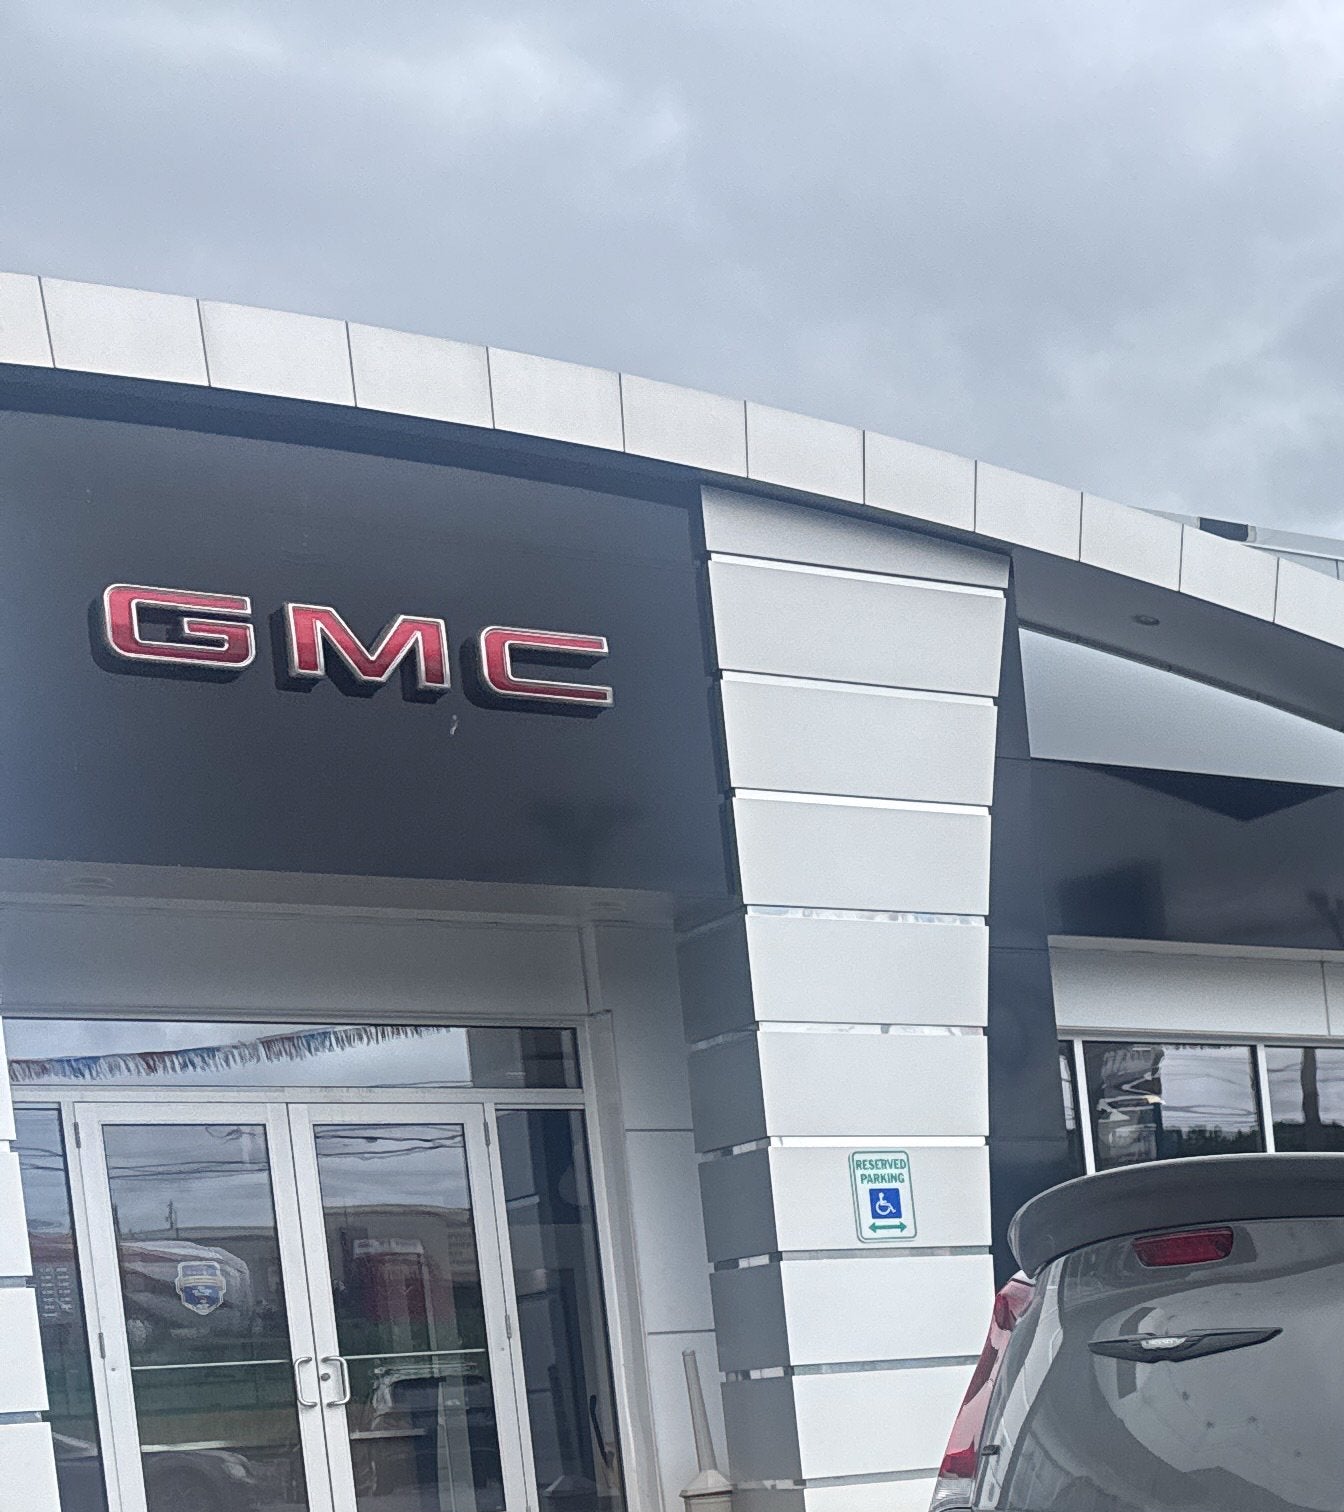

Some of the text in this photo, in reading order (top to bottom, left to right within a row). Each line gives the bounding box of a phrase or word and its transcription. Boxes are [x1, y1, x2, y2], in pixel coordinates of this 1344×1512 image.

[99, 582, 616, 708] GMC
[855, 1158, 907, 1171] RESERVED
[860, 1172, 905, 1185] PARKING
